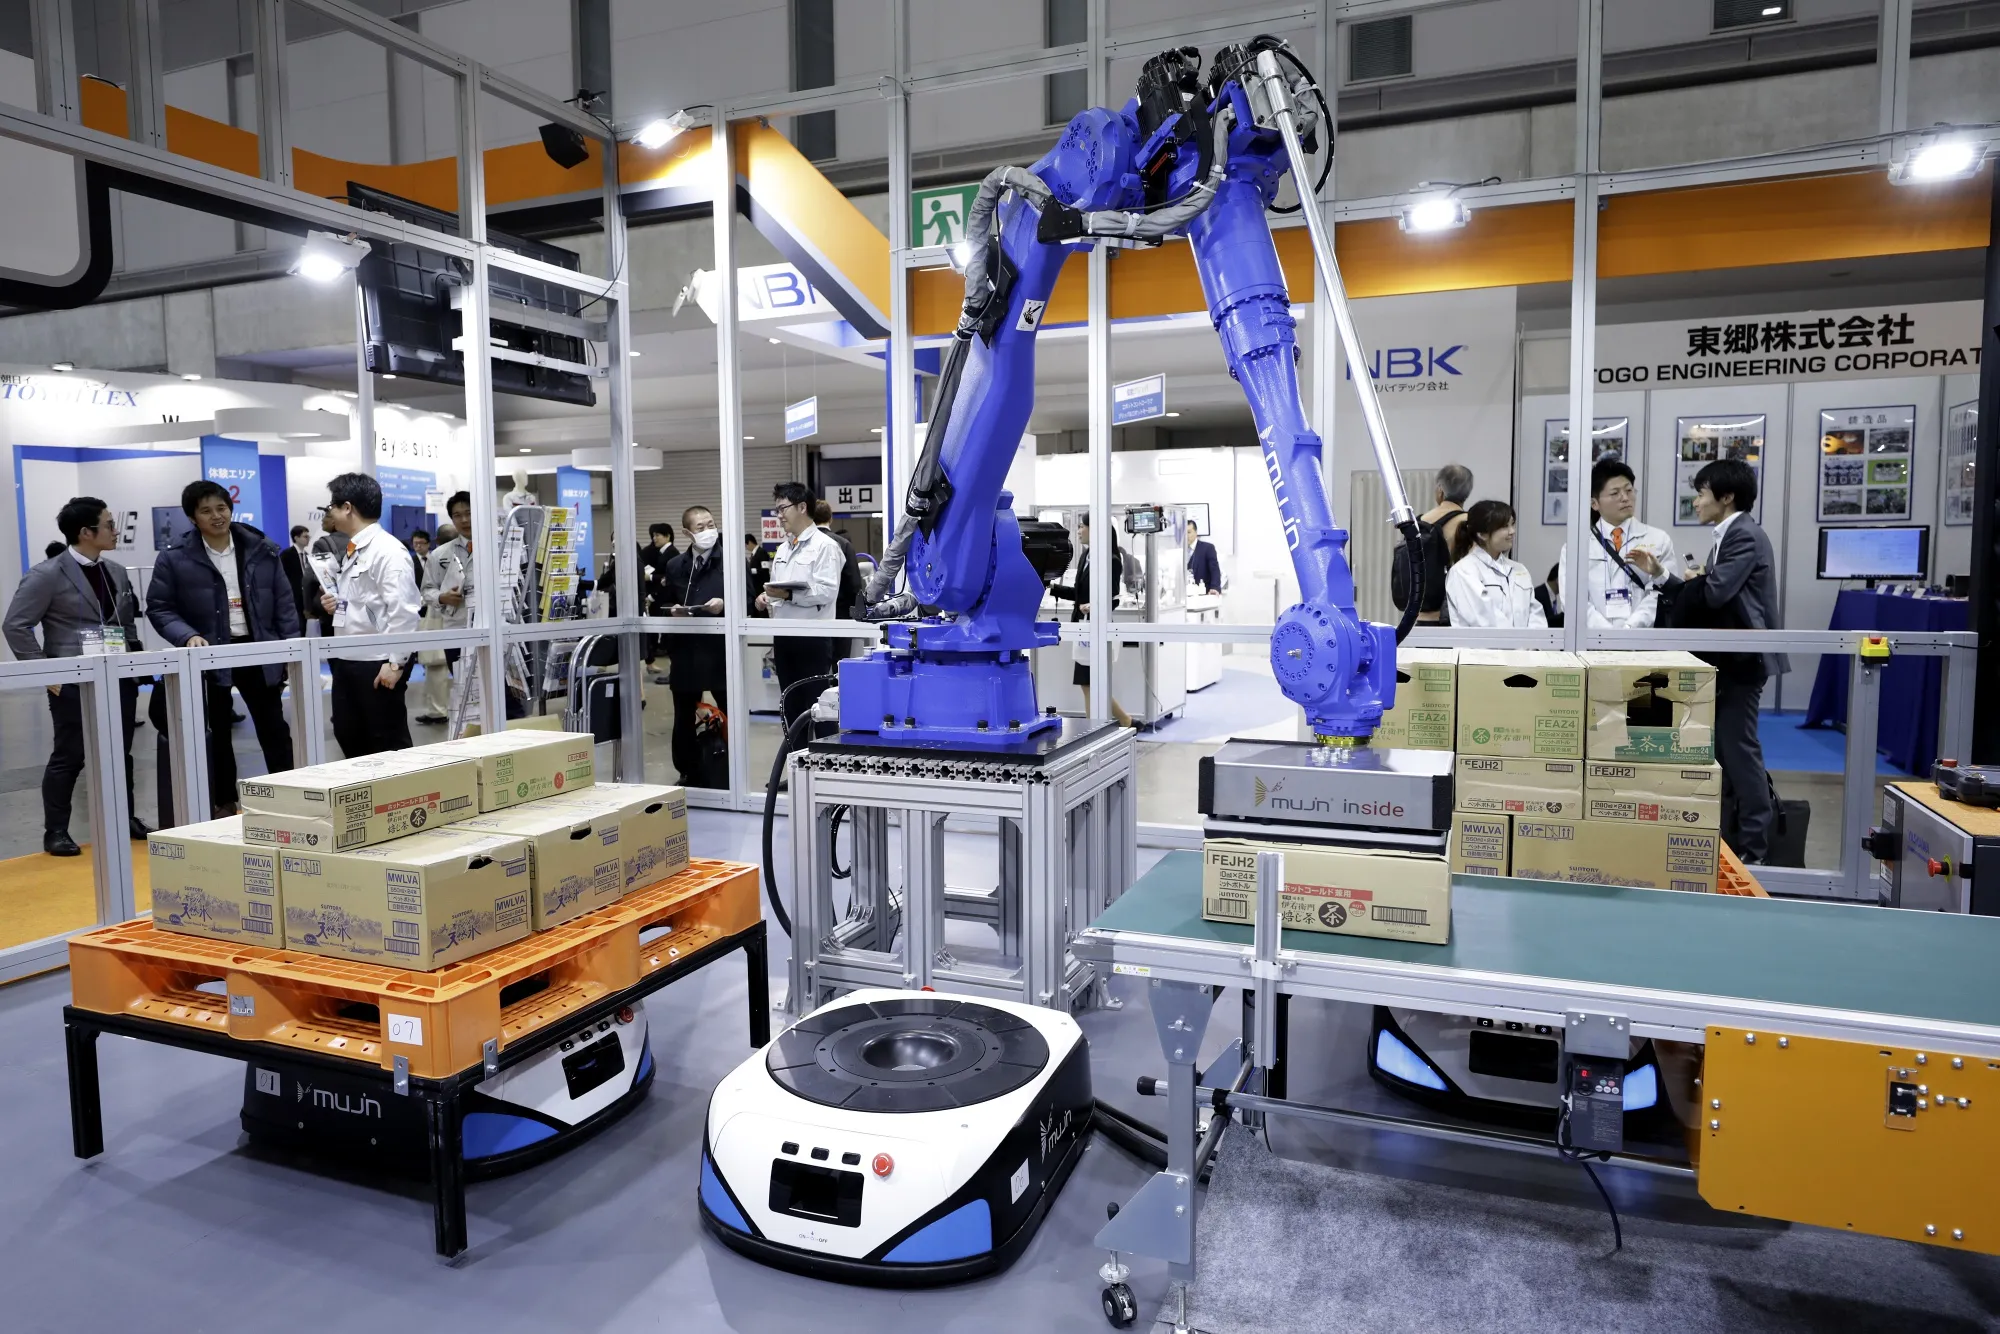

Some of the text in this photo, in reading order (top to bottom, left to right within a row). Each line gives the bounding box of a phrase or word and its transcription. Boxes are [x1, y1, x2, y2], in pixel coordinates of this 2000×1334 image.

[1687, 312, 1915, 357] 東郷株式会社
[1594, 366, 1648, 384] OGO
[1656, 355, 1826, 381] ENGINEERING
[208, 467, 256, 480] 体験エリア
[229, 485, 241, 504] 2
[838, 487, 873, 504] 出口
[1411, 713, 1447, 722] FEAZ4
[1537, 719, 1576, 729] FEAZ4
[1473, 729, 1489, 744] 茶
[496, 758, 512, 768] H3R
[1594, 767, 1631, 777] FEJH2
[245, 786, 271, 797] FEJH2
[339, 790, 369, 805] FEJH2
[1343, 799, 1404, 817] inside
[1464, 824, 1502, 835] MWLVA
[666, 834, 686, 847] MWLVA
[1669, 837, 1712, 848] MWLVA
[244, 857, 272, 868] MWLVA
[1212, 854, 1255, 868] FEJH2
[595, 863, 619, 877] MWLVA
[387, 873, 419, 885] MWLVA
[496, 895, 525, 911] MWLVA
[180, 903, 212, 922] 天然水
[1321, 904, 1344, 925] 茶
[316, 921, 352, 942] 天然水
[446, 924, 482, 949] 天然水
[393, 1019, 415, 1040] 07
[260, 1072, 274, 1091] 01
